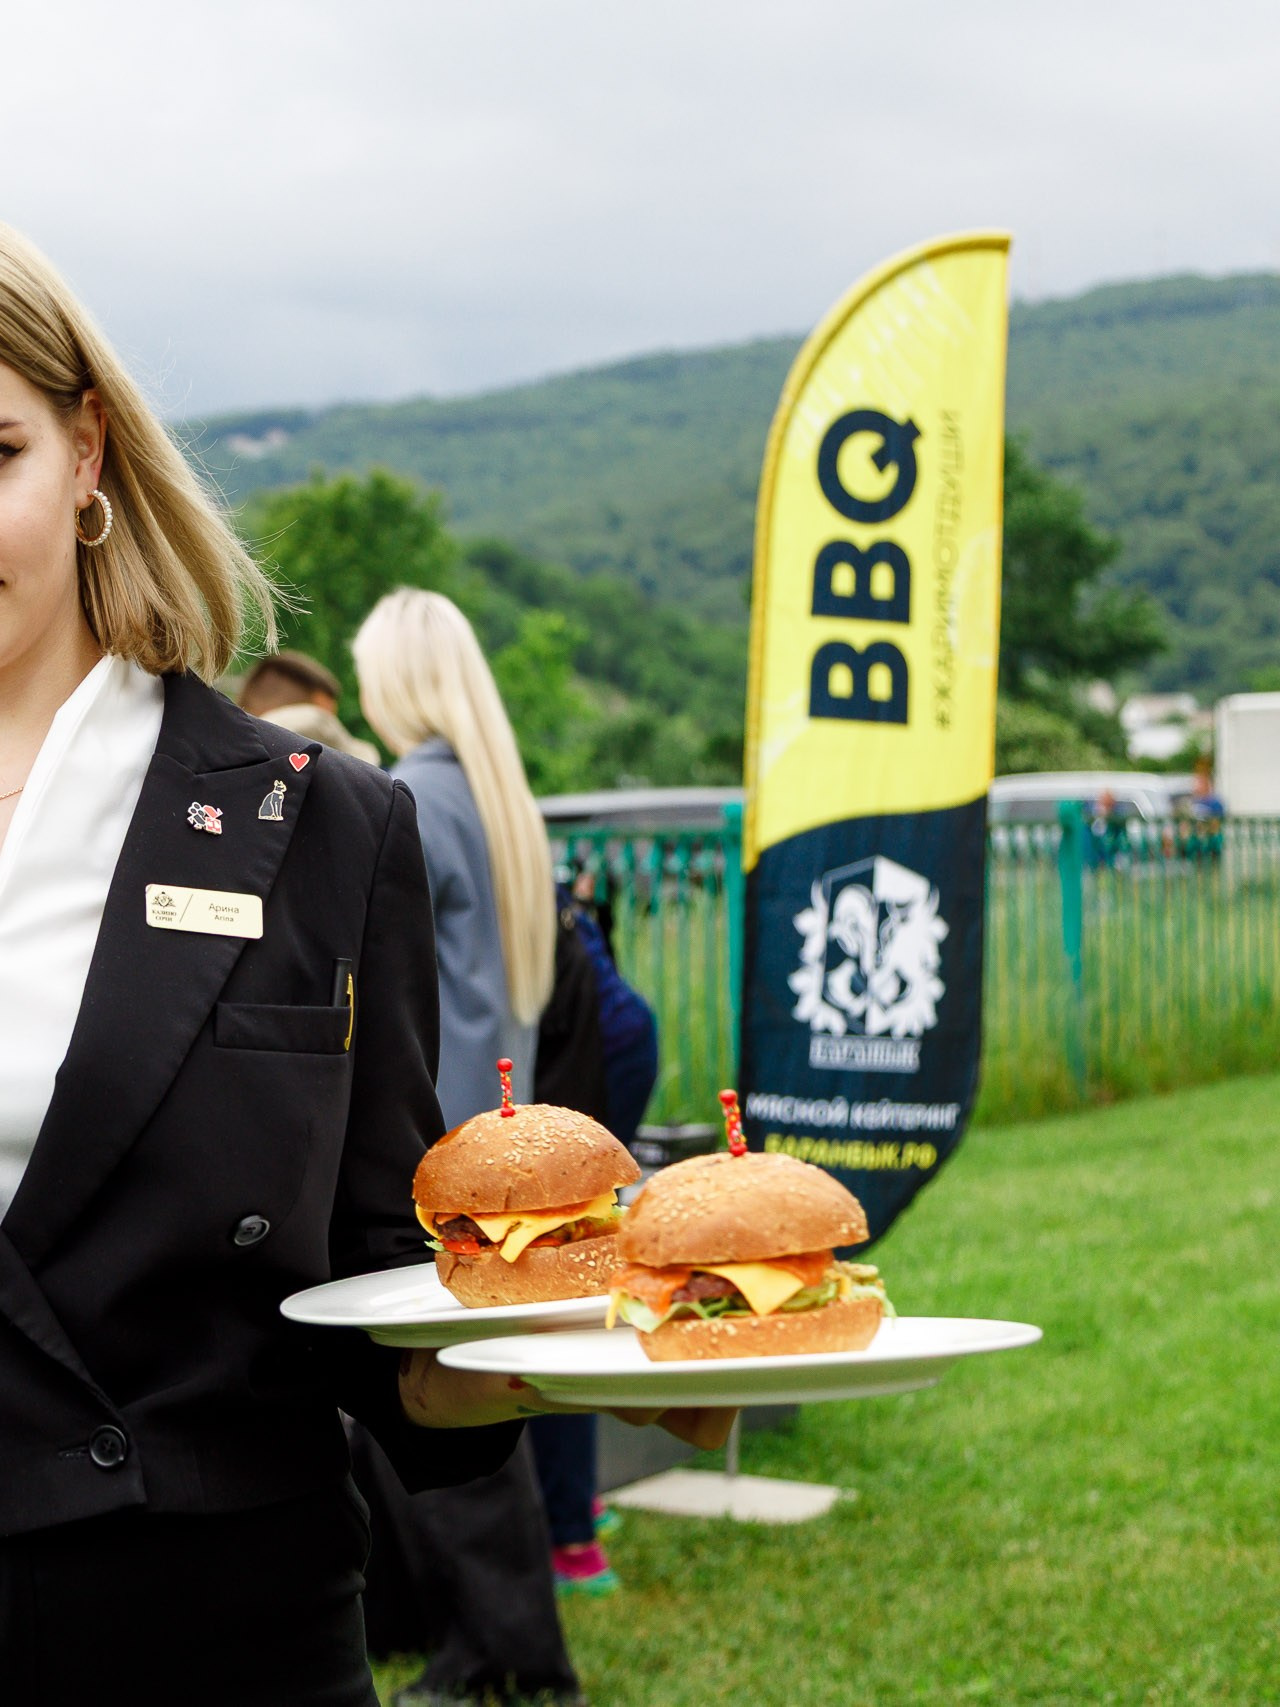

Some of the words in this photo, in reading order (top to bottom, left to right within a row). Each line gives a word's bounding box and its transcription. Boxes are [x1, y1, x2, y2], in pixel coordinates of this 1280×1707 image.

[808, 409, 922, 725] BBQ
[209, 903, 240, 914] Арина
[214, 914, 235, 922] Arina
[745, 1092, 848, 1128] МЯСНОЙ
[851, 1098, 960, 1130] КЕЙТЕРИНГ
